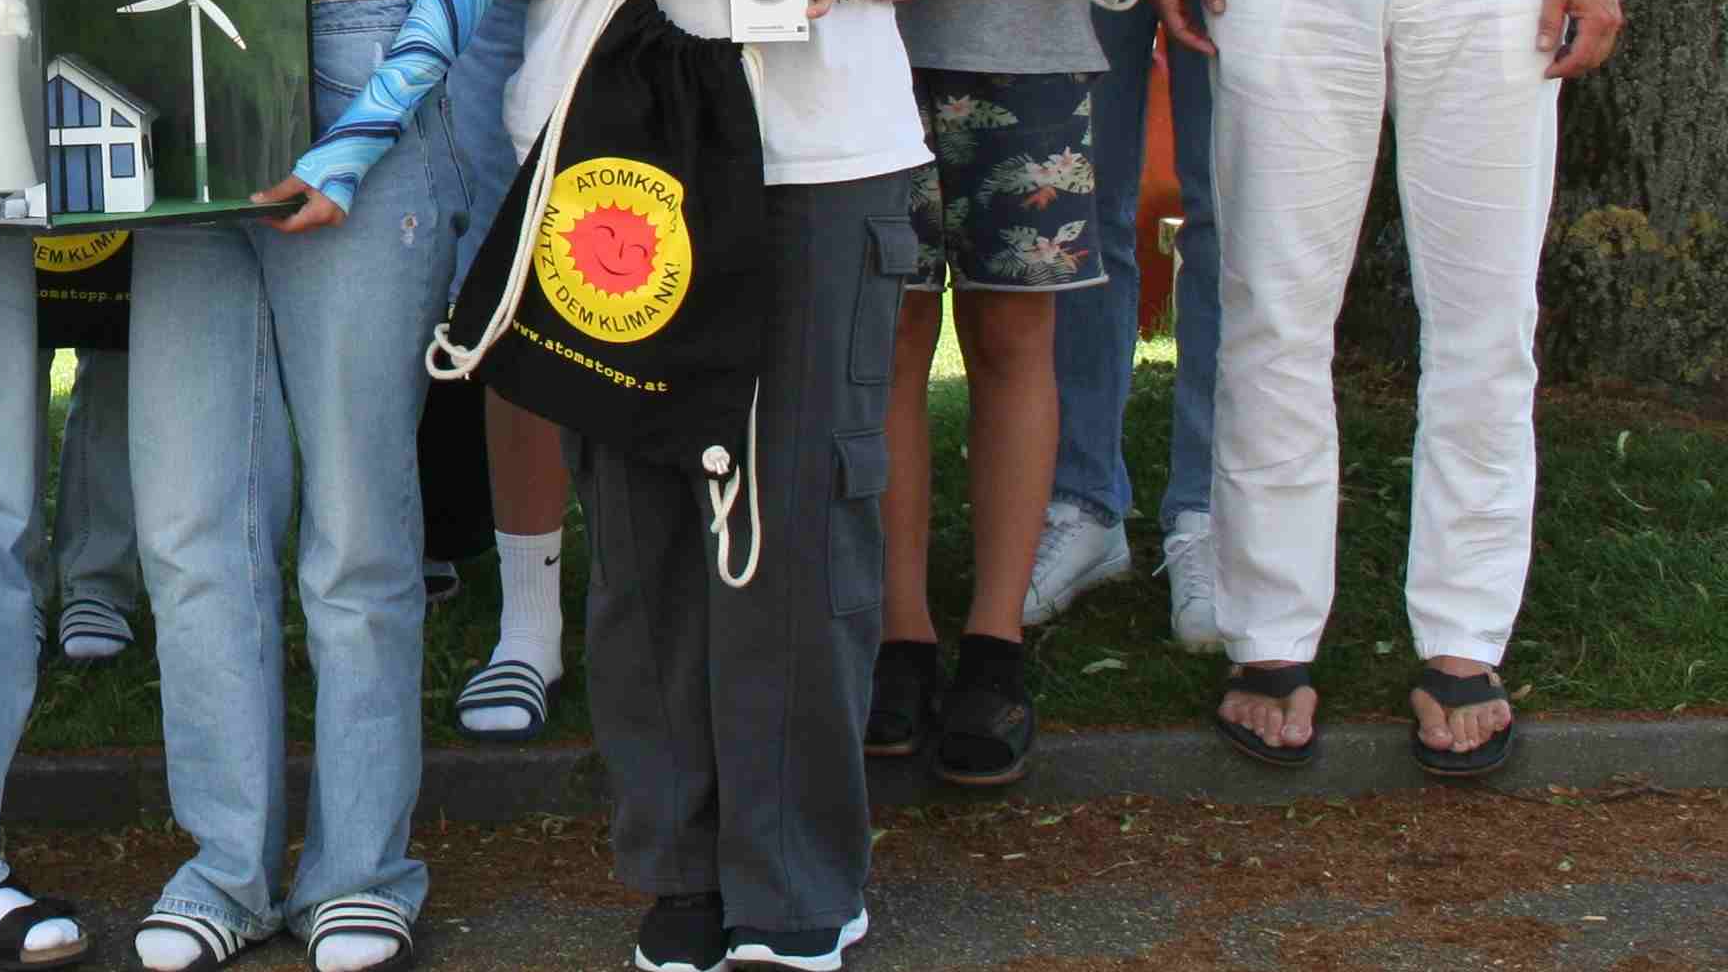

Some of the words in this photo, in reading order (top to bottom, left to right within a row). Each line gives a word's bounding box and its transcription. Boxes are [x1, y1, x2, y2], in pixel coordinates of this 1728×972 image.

[539, 203, 561, 282] NUTZT
[555, 285, 594, 326] DEM
[599, 304, 661, 333] KLIMA
[654, 261, 681, 305] NIX!
